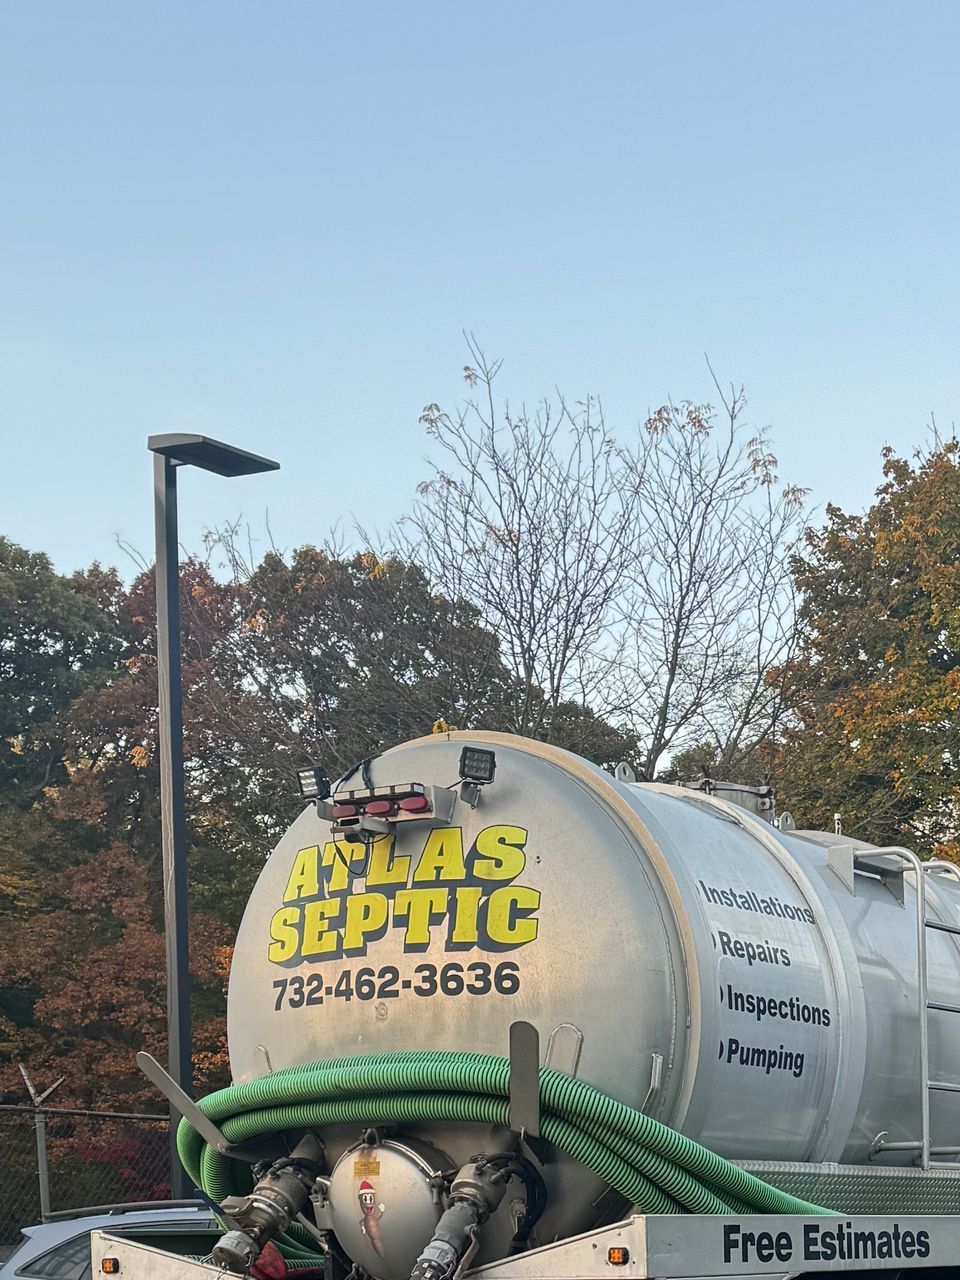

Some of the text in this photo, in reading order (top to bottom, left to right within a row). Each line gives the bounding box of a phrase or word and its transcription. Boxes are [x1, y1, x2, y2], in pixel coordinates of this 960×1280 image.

[283, 825, 528, 905] ATLAS
[699, 880, 816, 925] Installations
[268, 886, 541, 967] SEPTIC
[718, 931, 791, 967] Repairs
[273, 961, 520, 1011] 732-462-3636
[727, 984, 830, 1027] Inspections
[726, 1038, 804, 1077] Pumping
[723, 1222, 930, 1263] Free Estimates
